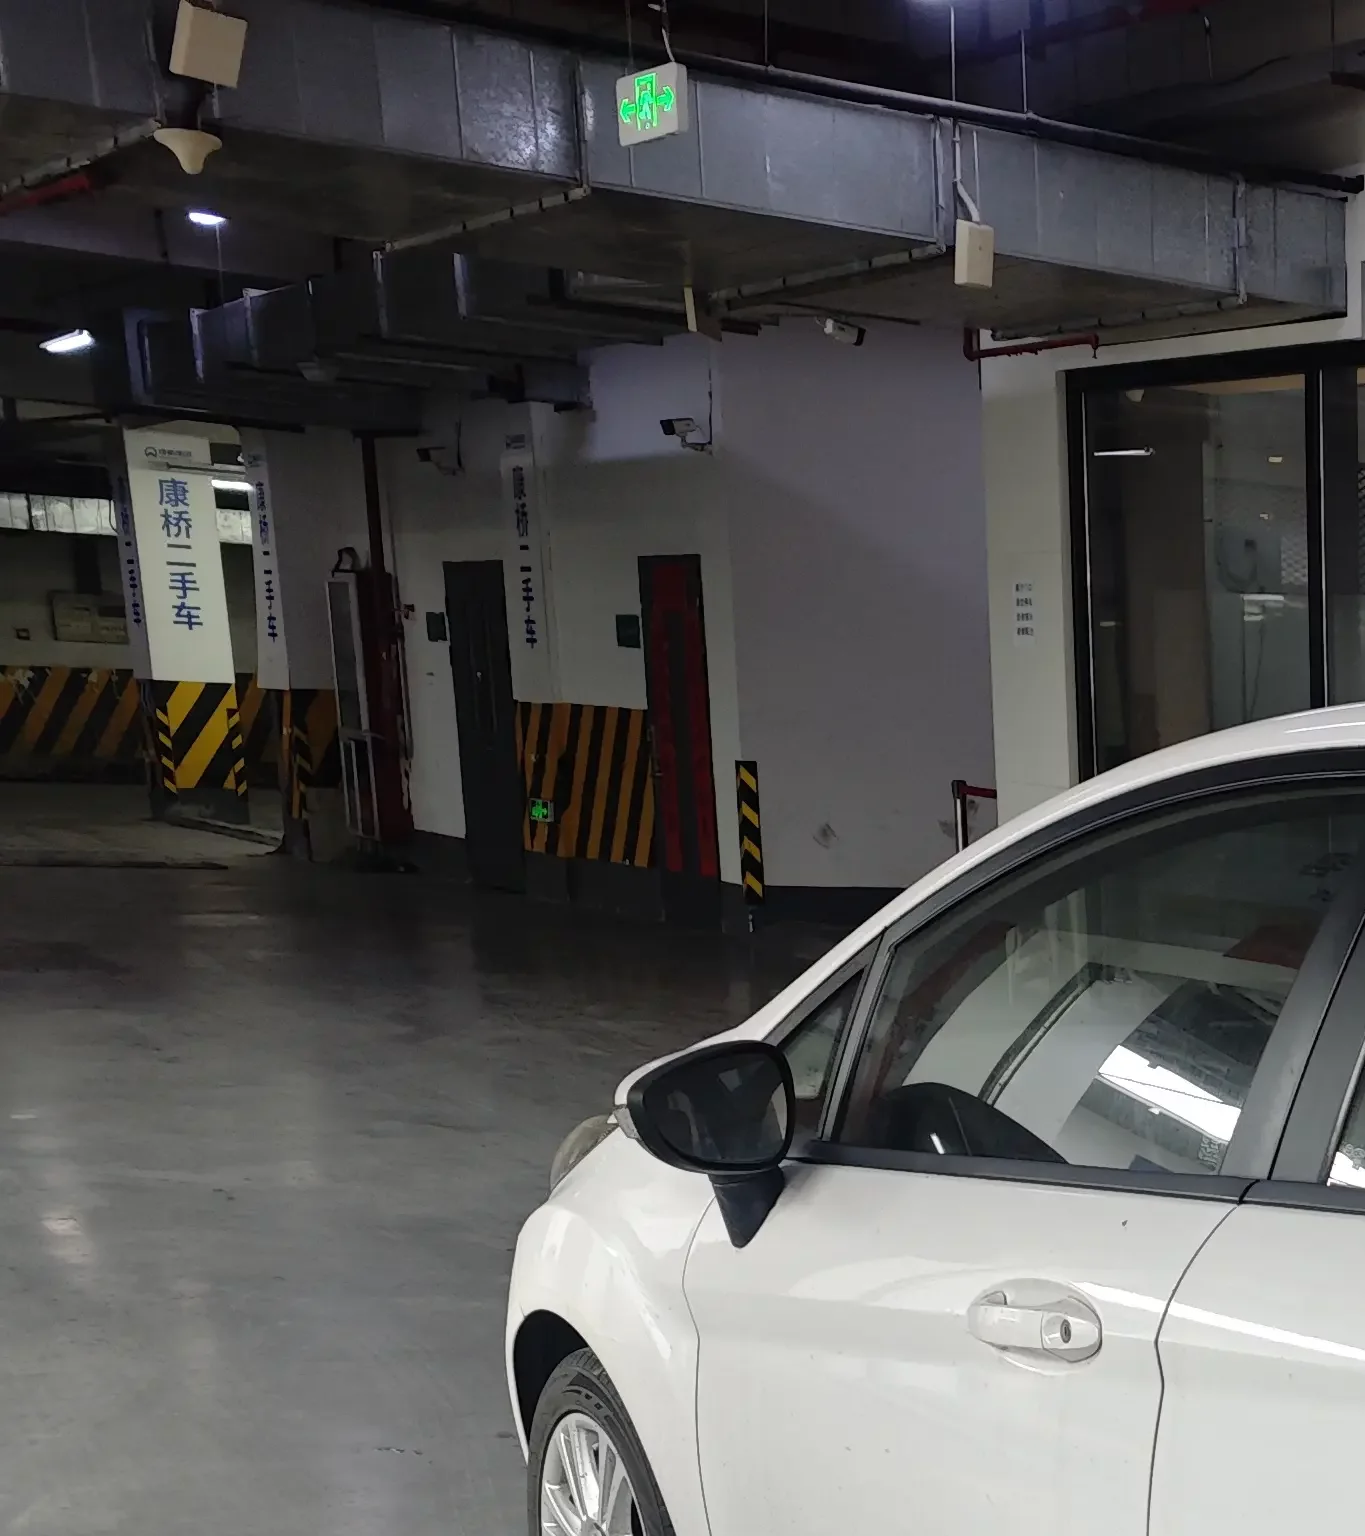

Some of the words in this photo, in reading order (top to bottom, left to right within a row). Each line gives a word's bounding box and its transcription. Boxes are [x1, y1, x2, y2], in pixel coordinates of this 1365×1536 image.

[158, 477, 203, 631] 康桥二手车
